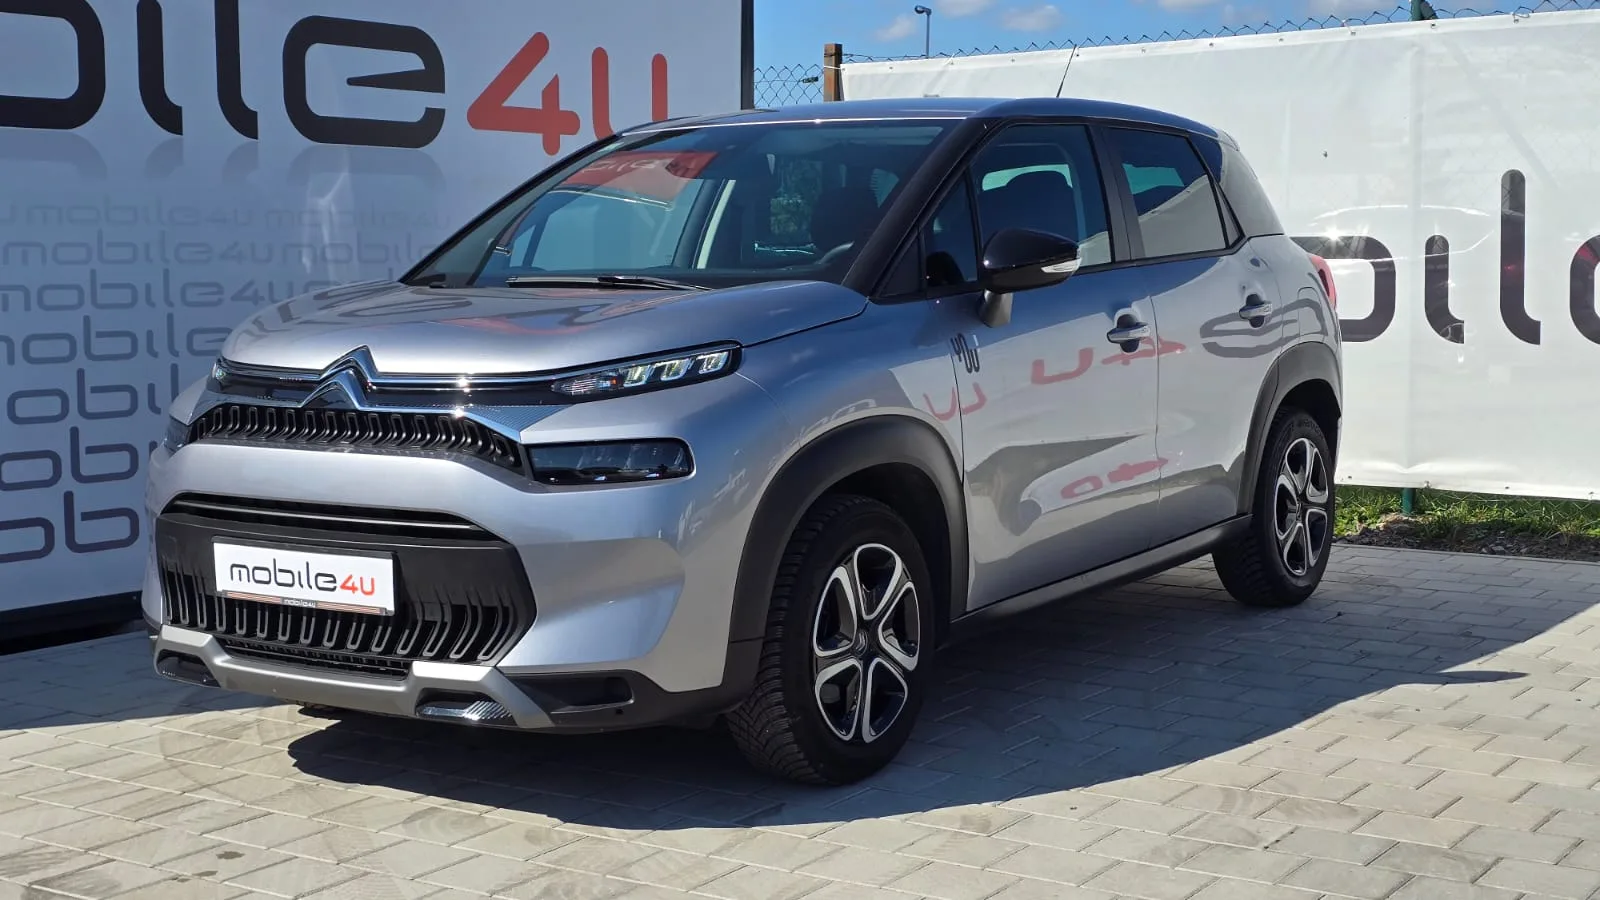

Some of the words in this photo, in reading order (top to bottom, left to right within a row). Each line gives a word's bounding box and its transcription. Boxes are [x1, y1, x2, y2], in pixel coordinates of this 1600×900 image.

[1290, 168, 1600, 345] il
[0, 312, 232, 366] obile
[0, 426, 157, 491] ob
[230, 558, 375, 595] mobile4U
